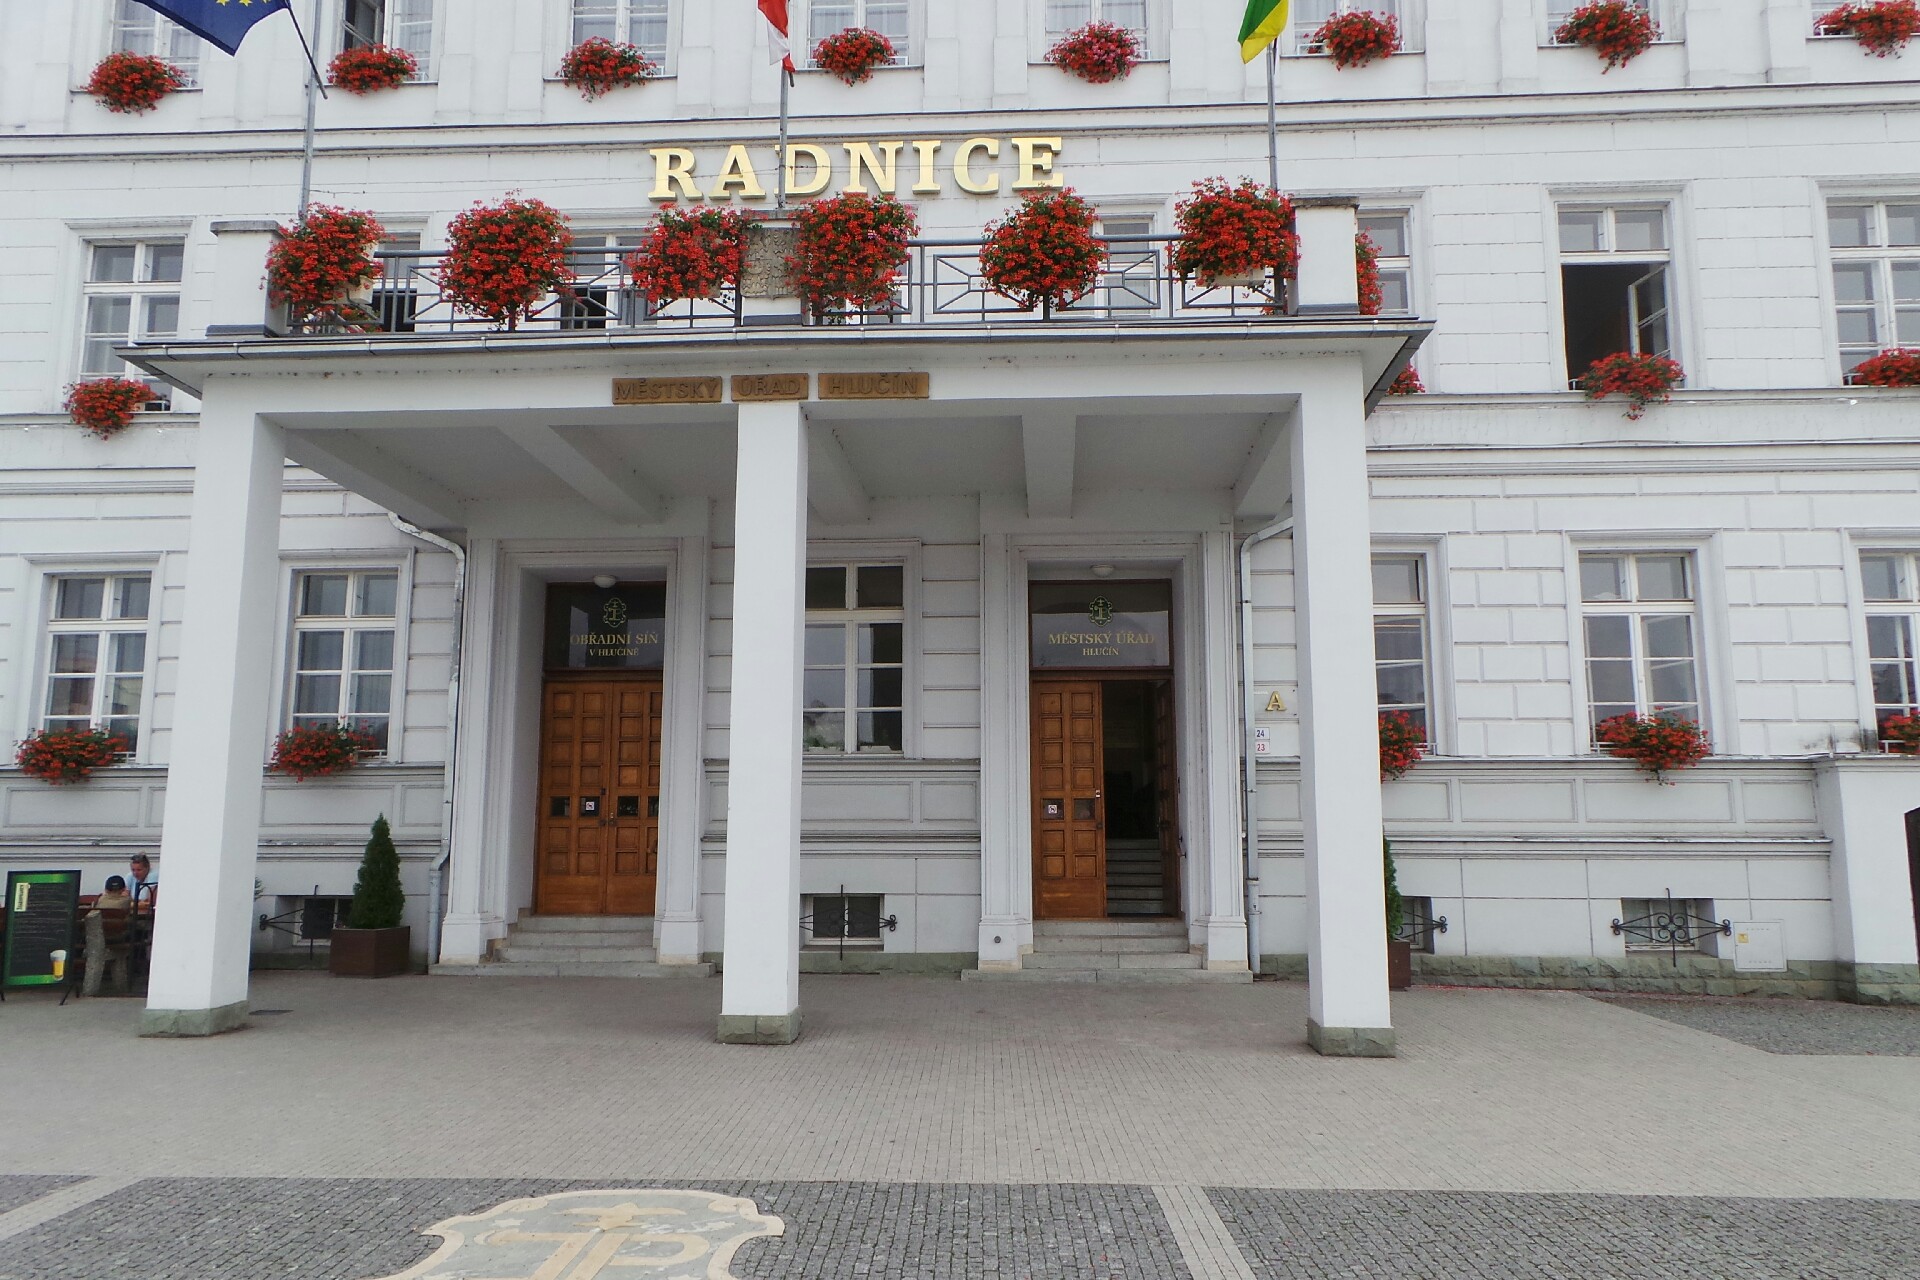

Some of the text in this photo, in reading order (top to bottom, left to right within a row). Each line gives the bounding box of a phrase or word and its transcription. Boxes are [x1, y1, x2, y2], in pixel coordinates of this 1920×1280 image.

[647, 136, 1064, 202] RADNICE
[614, 372, 919, 401] MĚSTSKÝ ÚŘAD HLUČÍN
[570, 630, 631, 645] OBŘADNÍ
[1048, 630, 1154, 644] MĚSTSKÝ ÚŘAD
[589, 648, 595, 656] V
[1082, 646, 1119, 656] HLUČÍN
[1265, 690, 1287, 712] A
[1256, 729, 1265, 738] 24
[1256, 743, 1265, 752] 23
